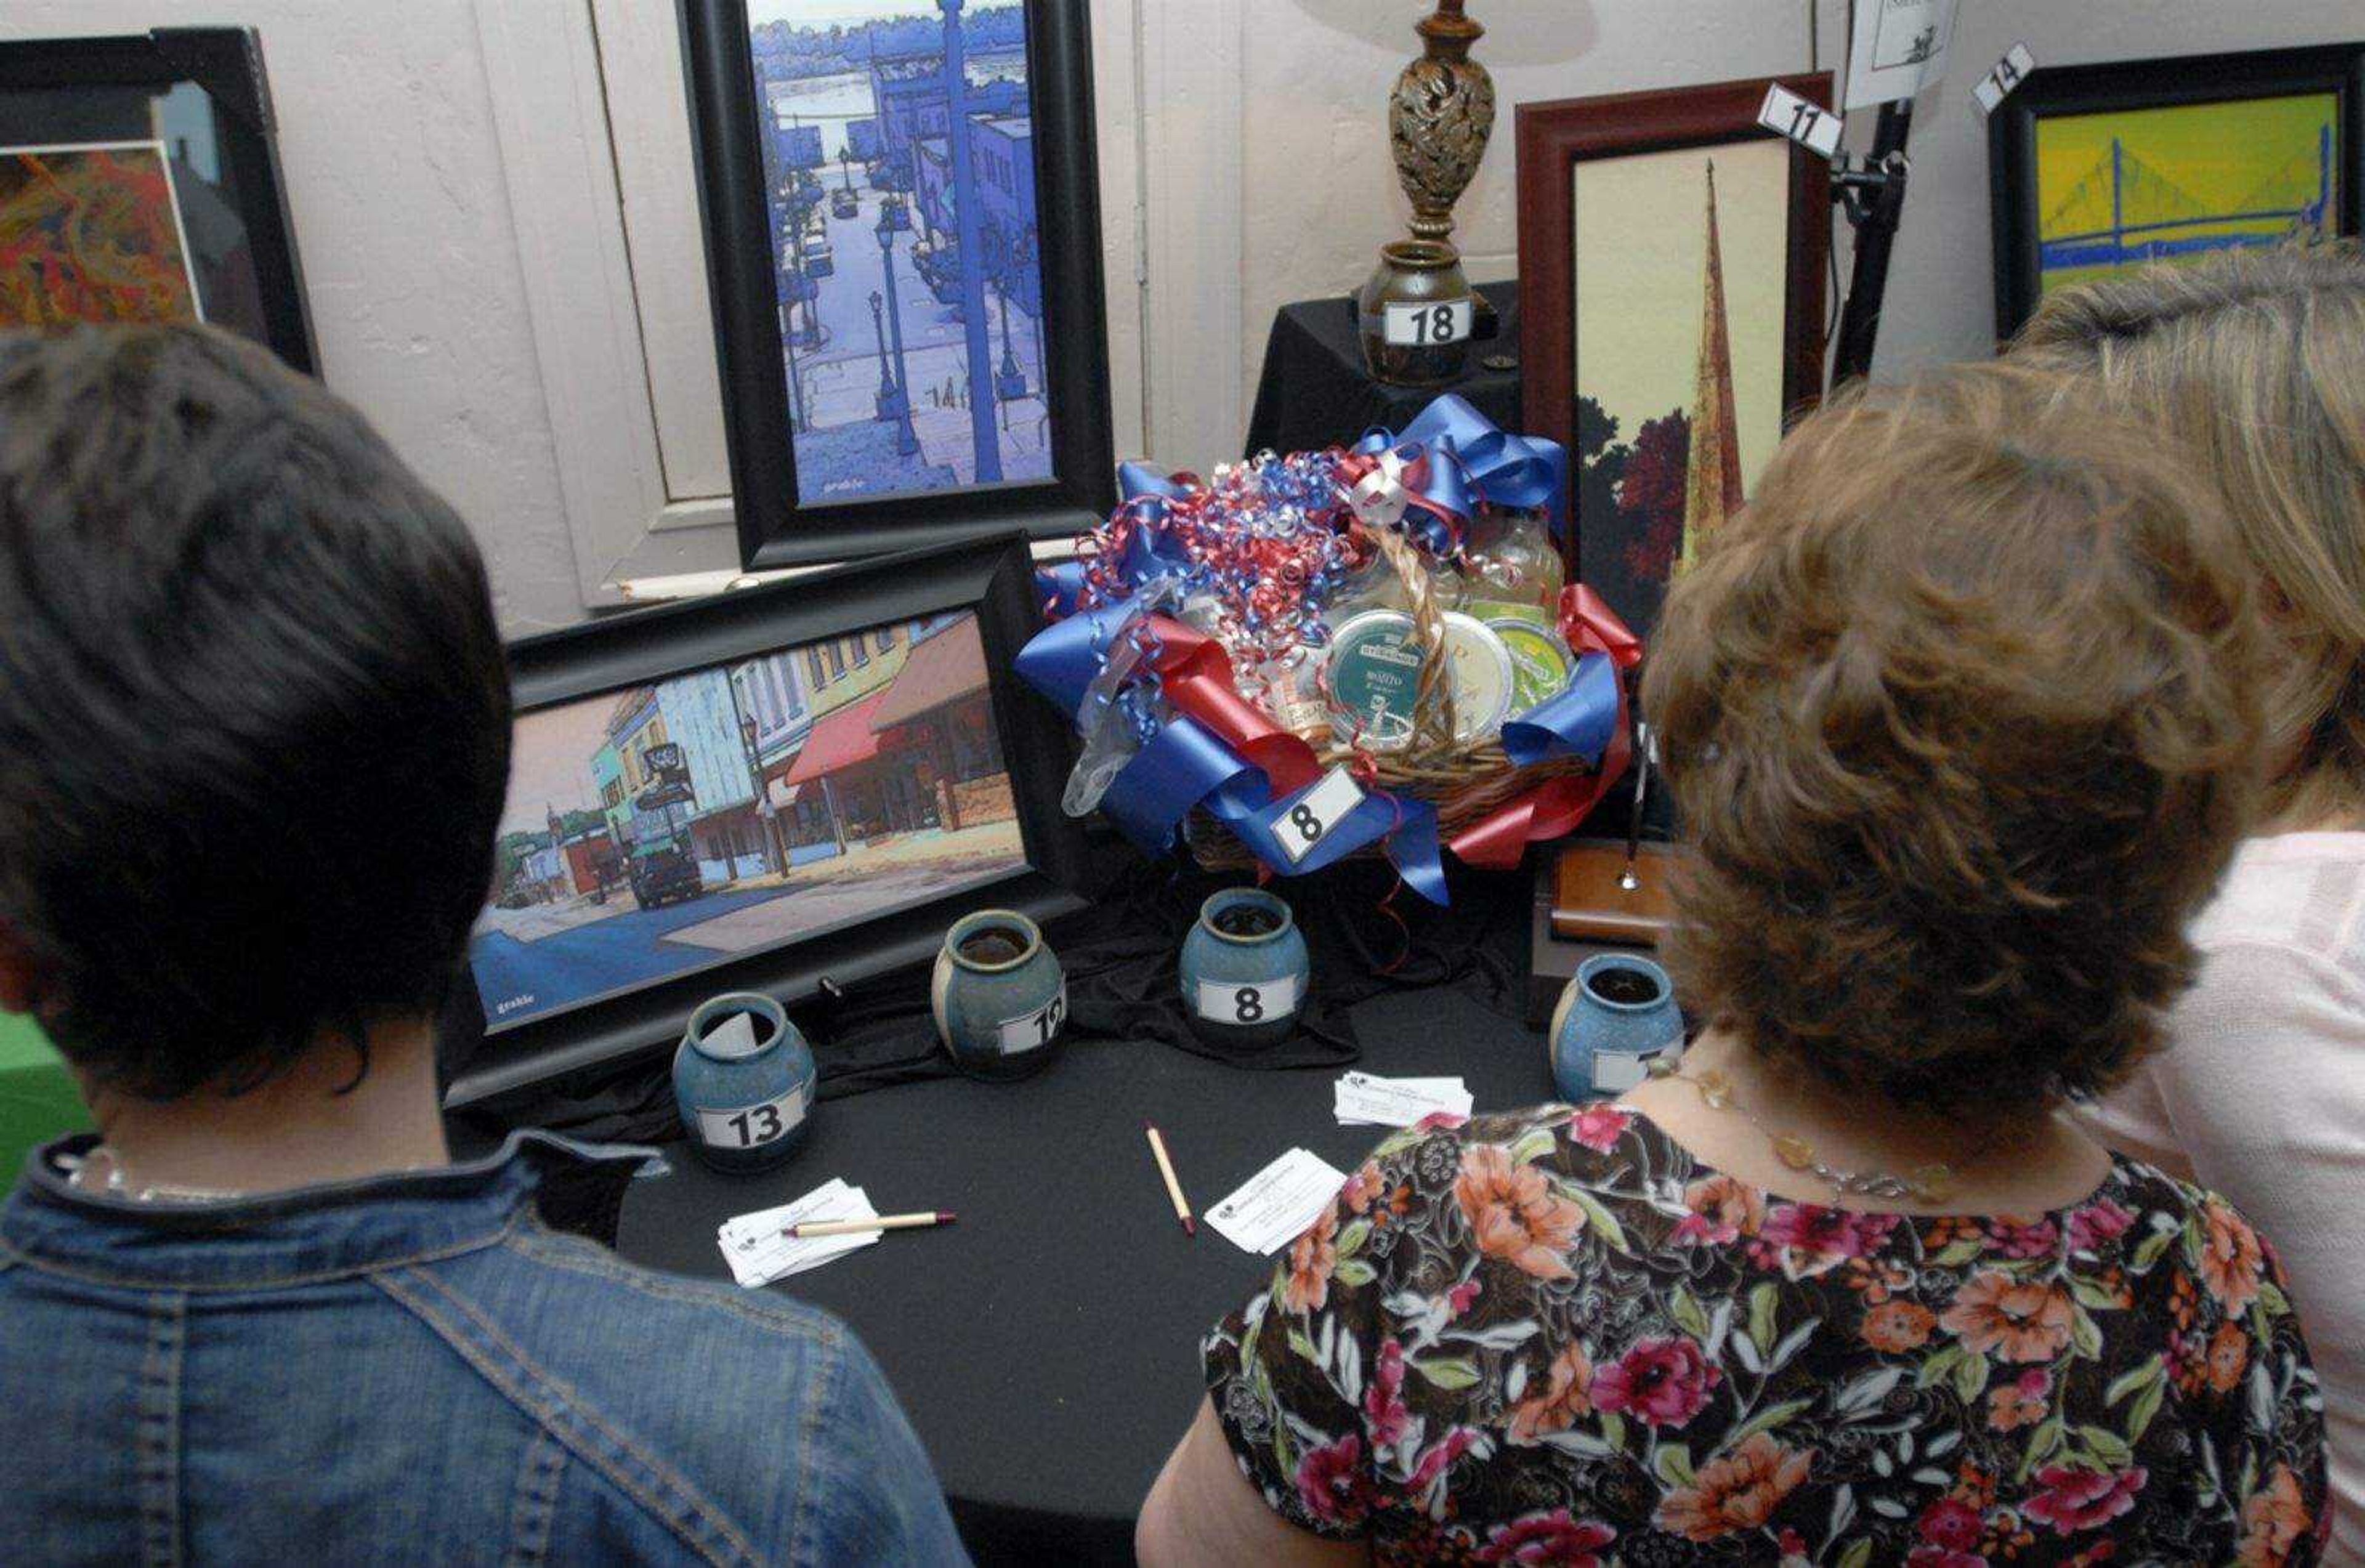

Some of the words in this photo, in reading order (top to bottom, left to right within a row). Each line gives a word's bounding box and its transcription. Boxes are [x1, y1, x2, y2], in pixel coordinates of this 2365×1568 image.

[1989, 57, 2019, 96] 14
[1789, 102, 1821, 141] 11
[1411, 305, 1454, 342] 18
[1292, 803, 1322, 841] 8
[1234, 987, 1263, 1022] 8
[729, 1104, 782, 1146] 13
